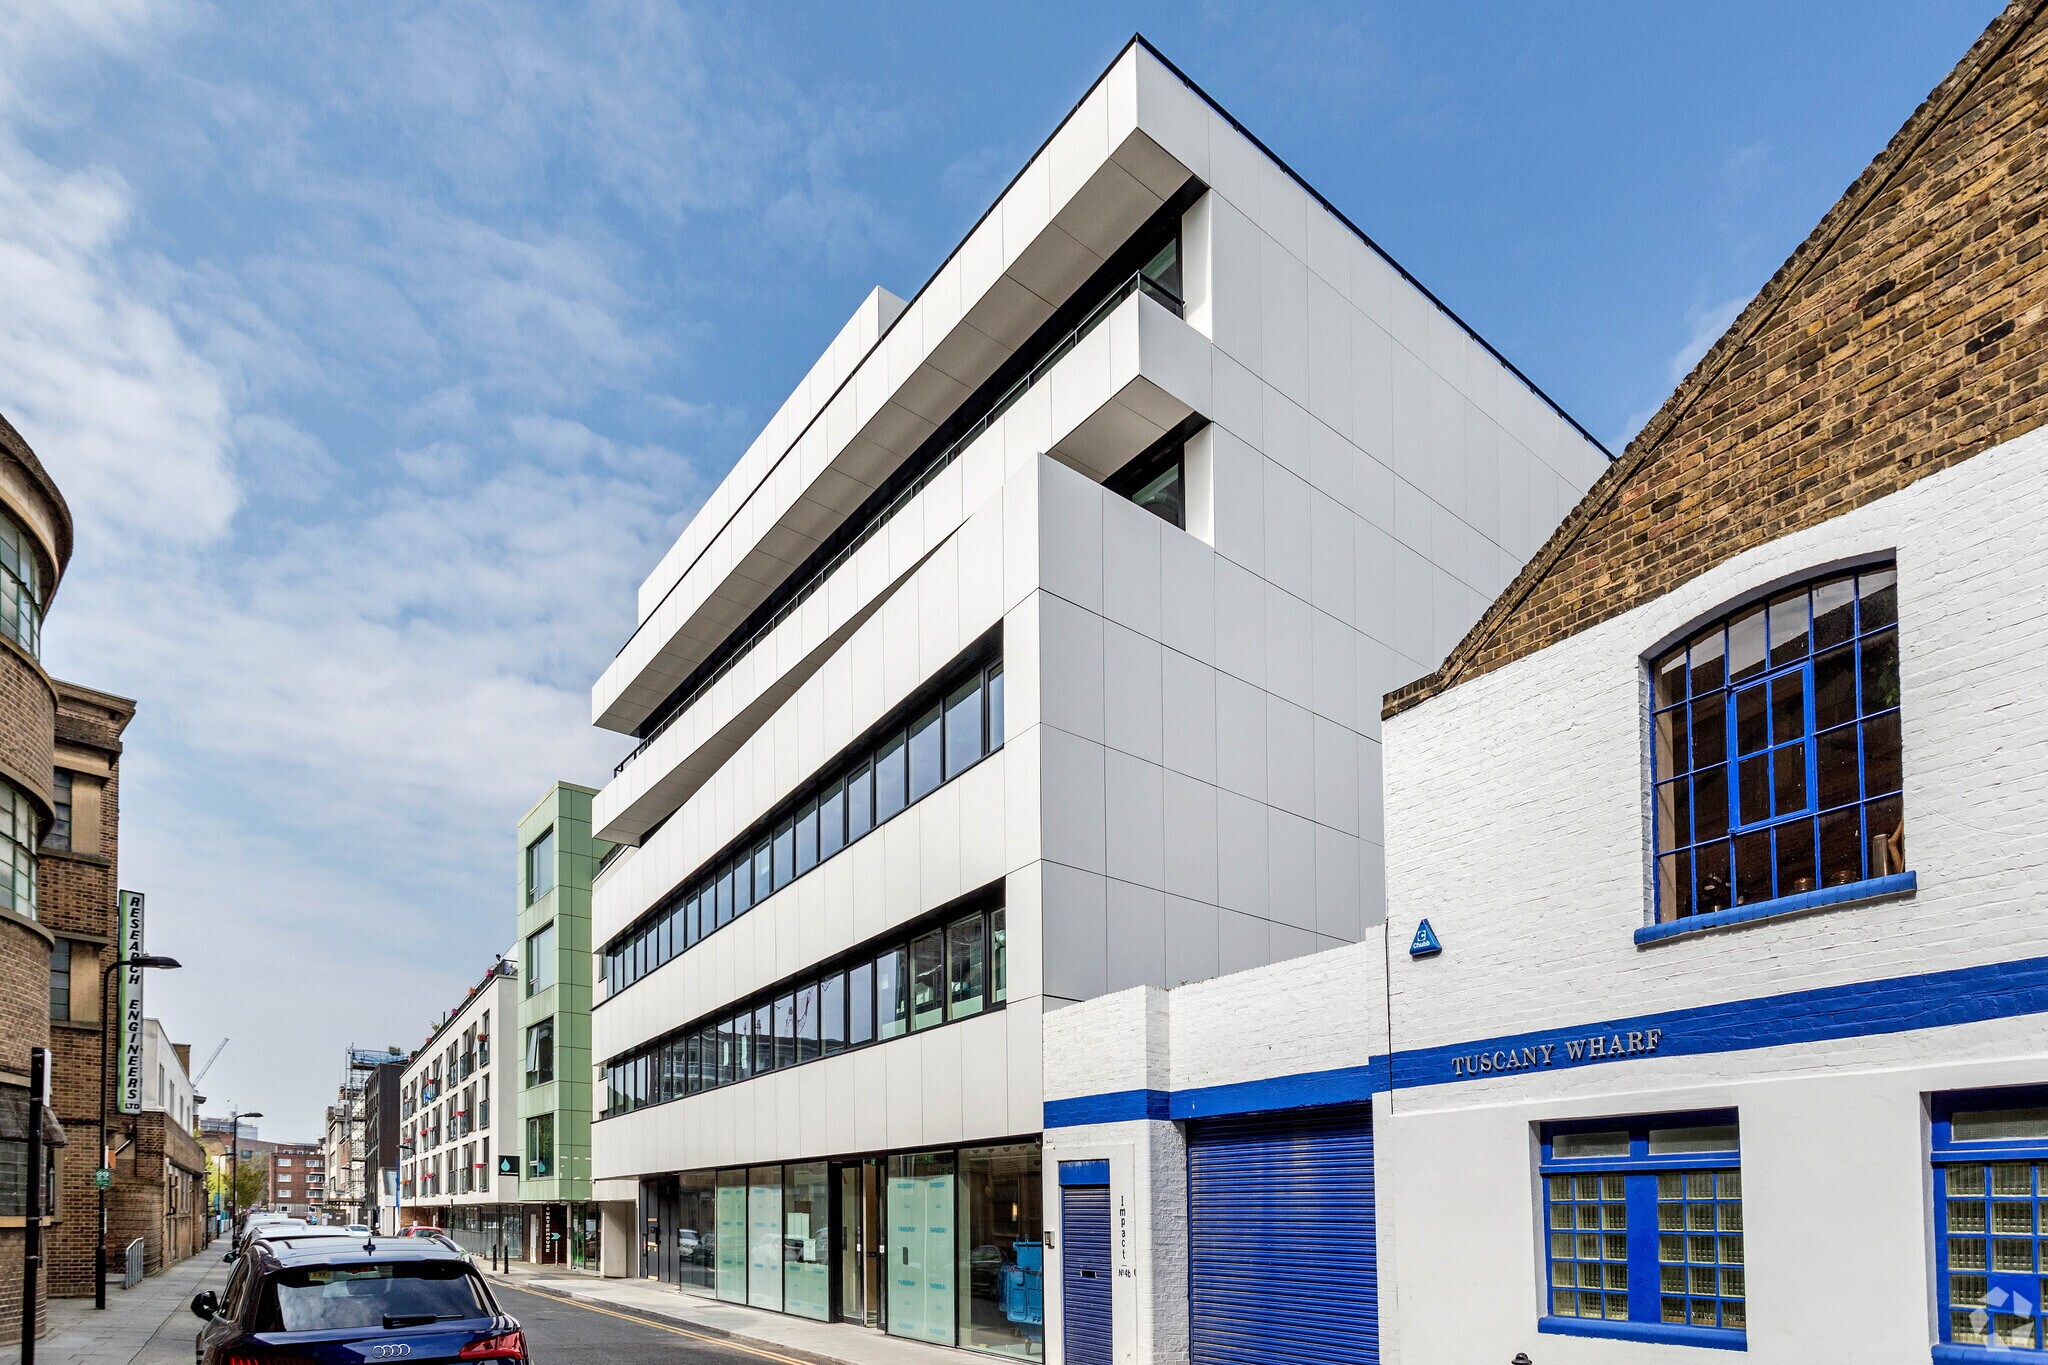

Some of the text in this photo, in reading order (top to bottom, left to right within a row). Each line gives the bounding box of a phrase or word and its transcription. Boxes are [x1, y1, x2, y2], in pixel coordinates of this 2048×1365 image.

[1413, 940, 1430, 949] Chubb
[127, 999, 140, 1099] ENGINEERS
[1452, 1028, 1662, 1076] TUSCANY WHARF
[125, 1102, 140, 1110] LTD
